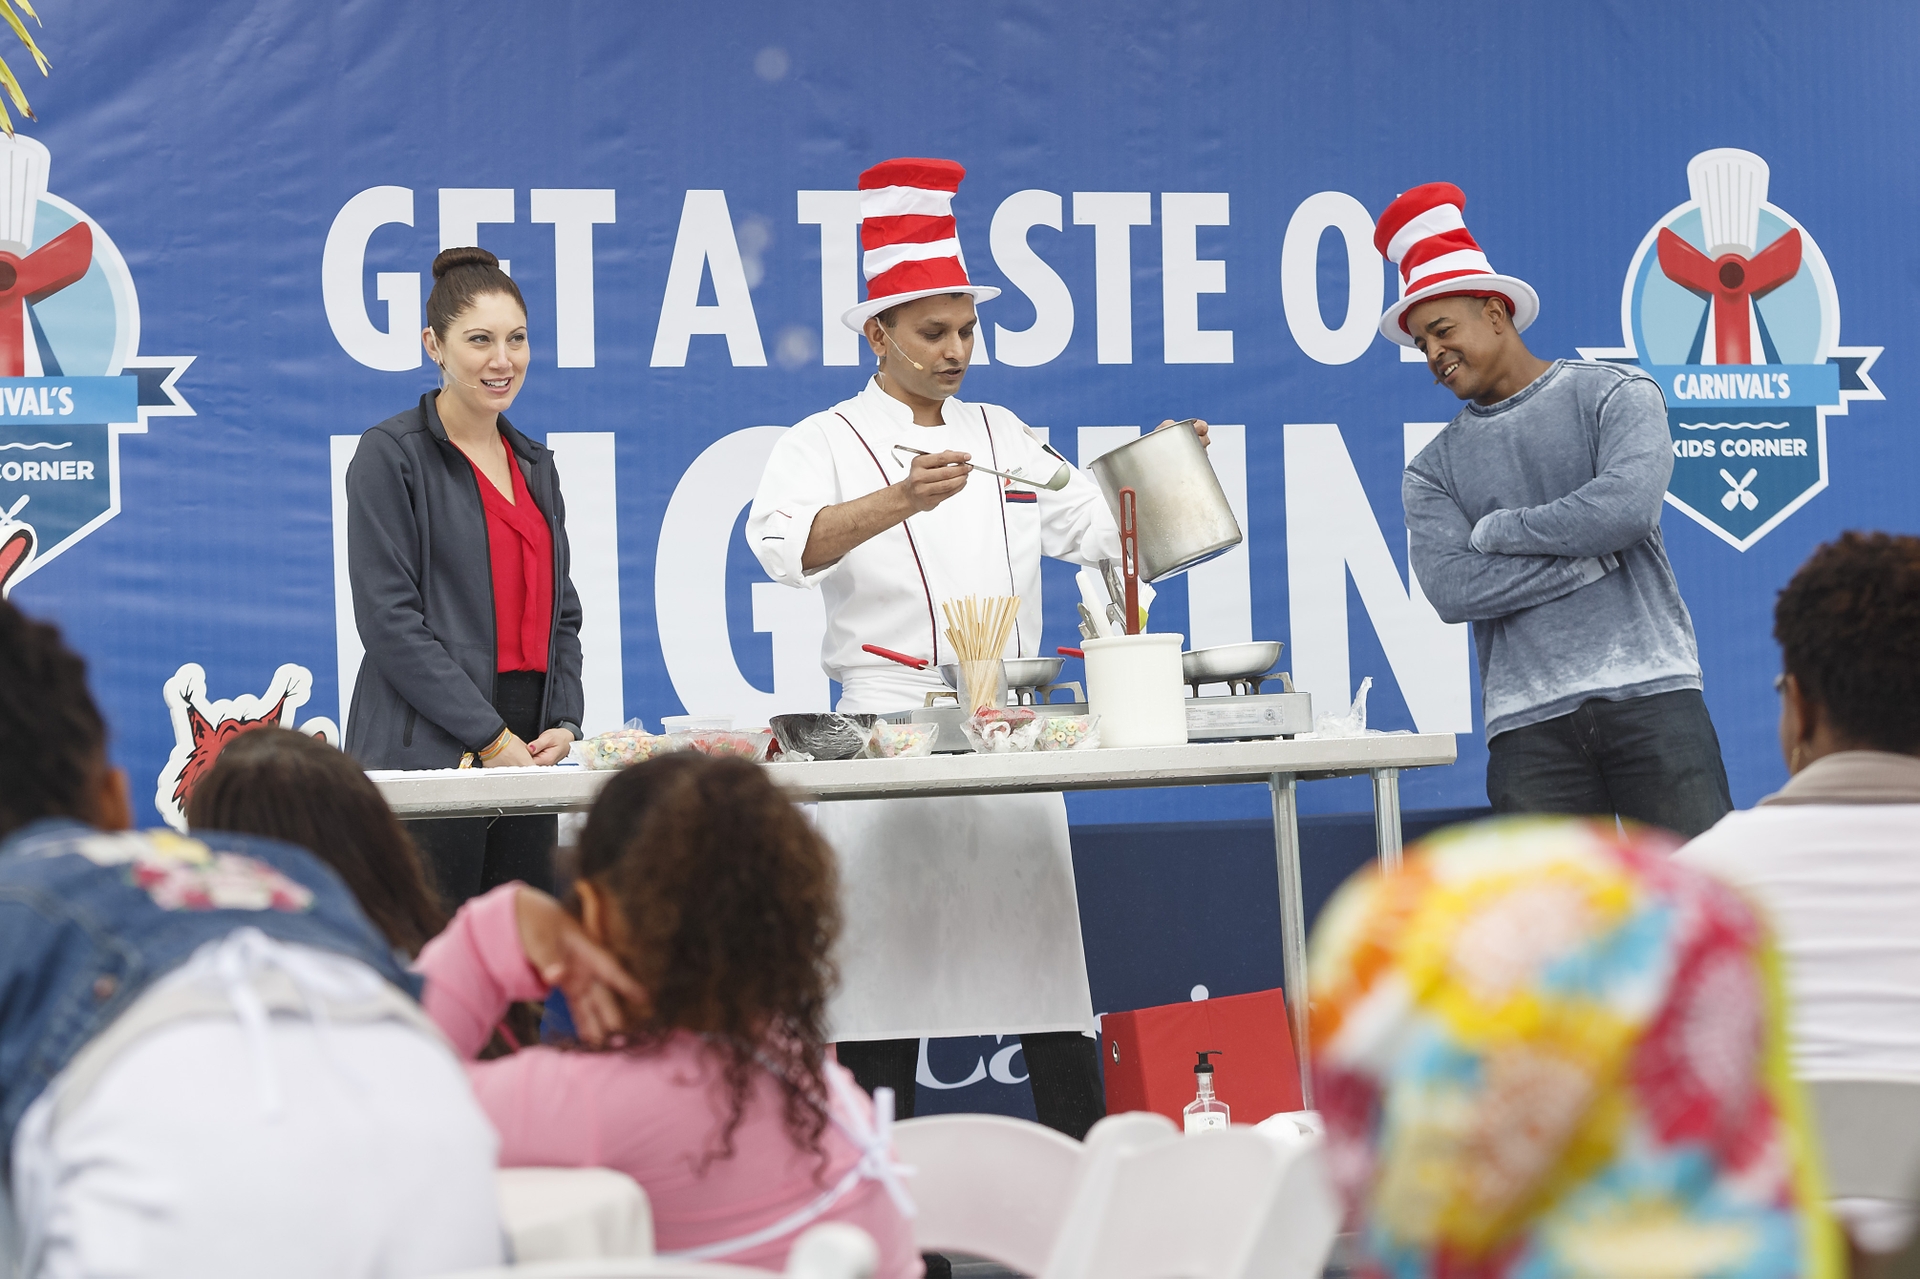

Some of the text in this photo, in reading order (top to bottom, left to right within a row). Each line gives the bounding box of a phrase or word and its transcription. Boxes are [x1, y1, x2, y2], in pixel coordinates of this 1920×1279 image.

[649, 189, 768, 367] A
[1281, 190, 1428, 366] O
[1673, 373, 1791, 400] CARNIVAL'S
[1720, 438, 1808, 458] CORNER
[0, 460, 95, 482] ORNER
